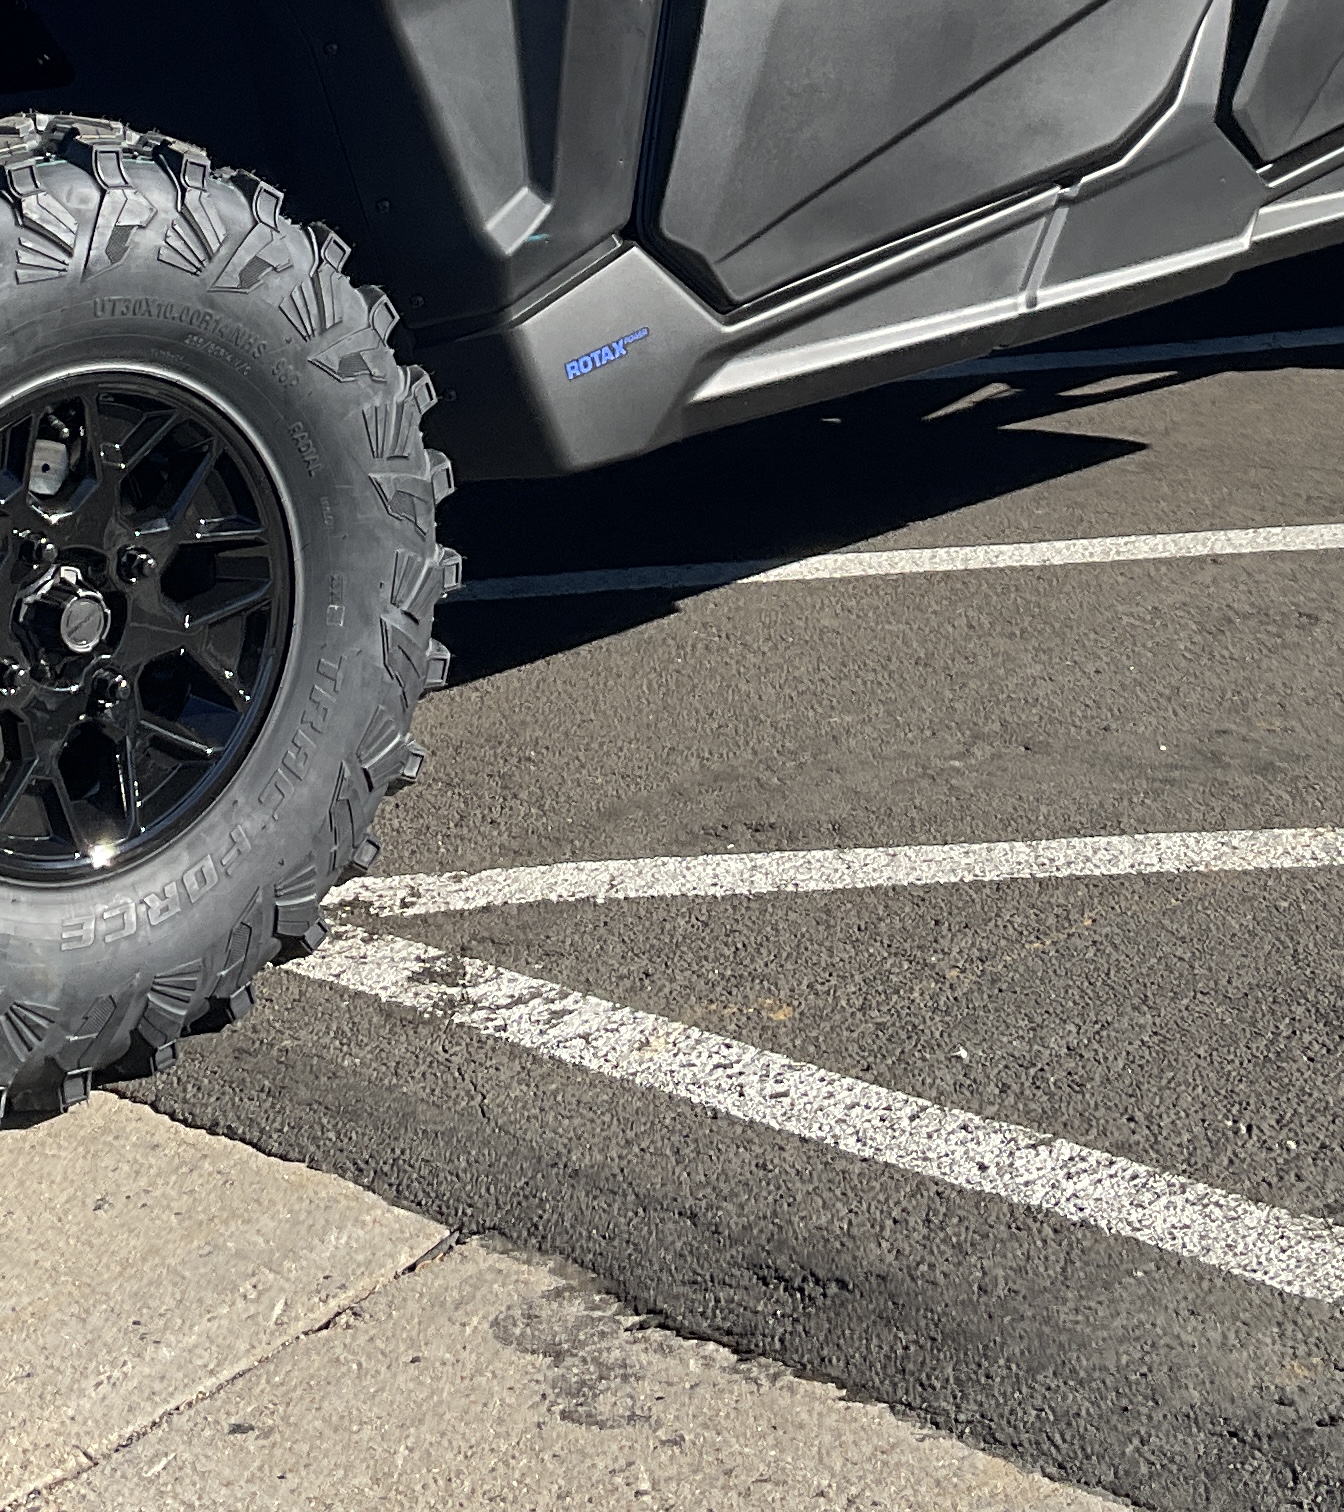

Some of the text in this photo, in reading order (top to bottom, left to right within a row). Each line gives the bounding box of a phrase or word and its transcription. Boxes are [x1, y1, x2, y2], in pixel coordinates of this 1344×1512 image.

[565, 338, 627, 380] ROTAX
[287, 421, 324, 478] RADIAL
[60, 824, 251, 951] FORCE
